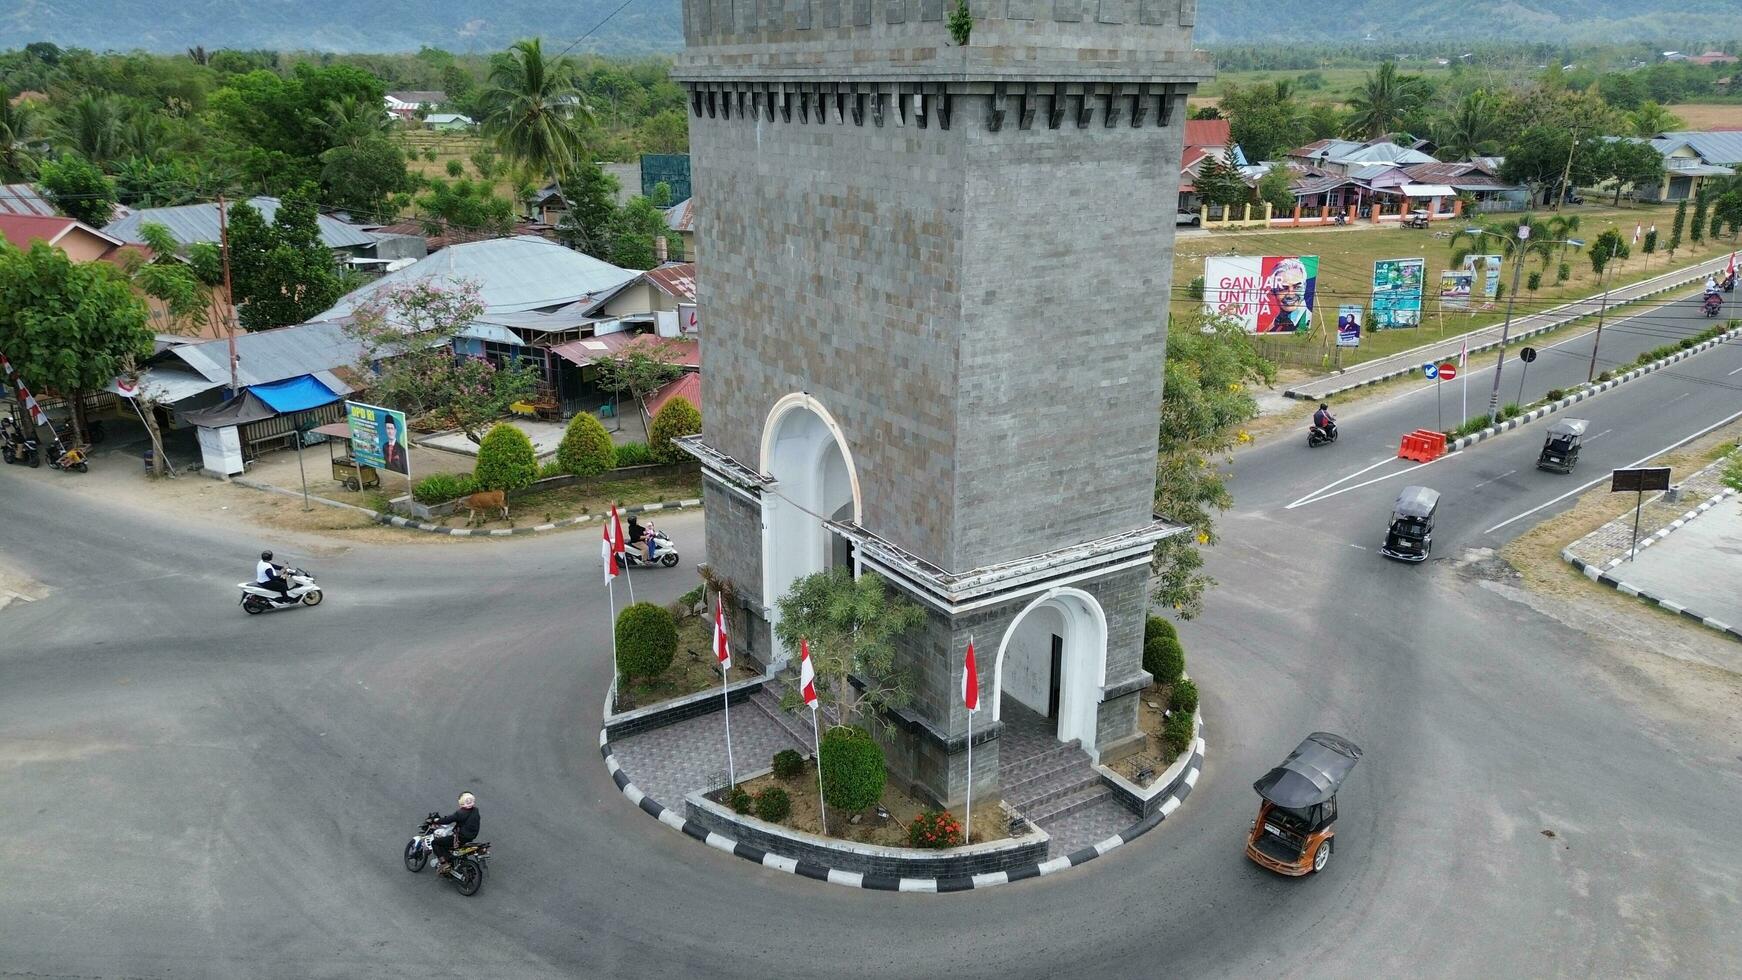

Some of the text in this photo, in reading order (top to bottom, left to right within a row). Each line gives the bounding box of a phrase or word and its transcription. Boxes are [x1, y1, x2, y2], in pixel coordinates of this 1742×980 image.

[1220, 276, 1284, 290] GANJAR
[1219, 289, 1270, 303] UNTUK
[1218, 302, 1271, 315] SMUA
[351, 406, 366, 419] DPD
